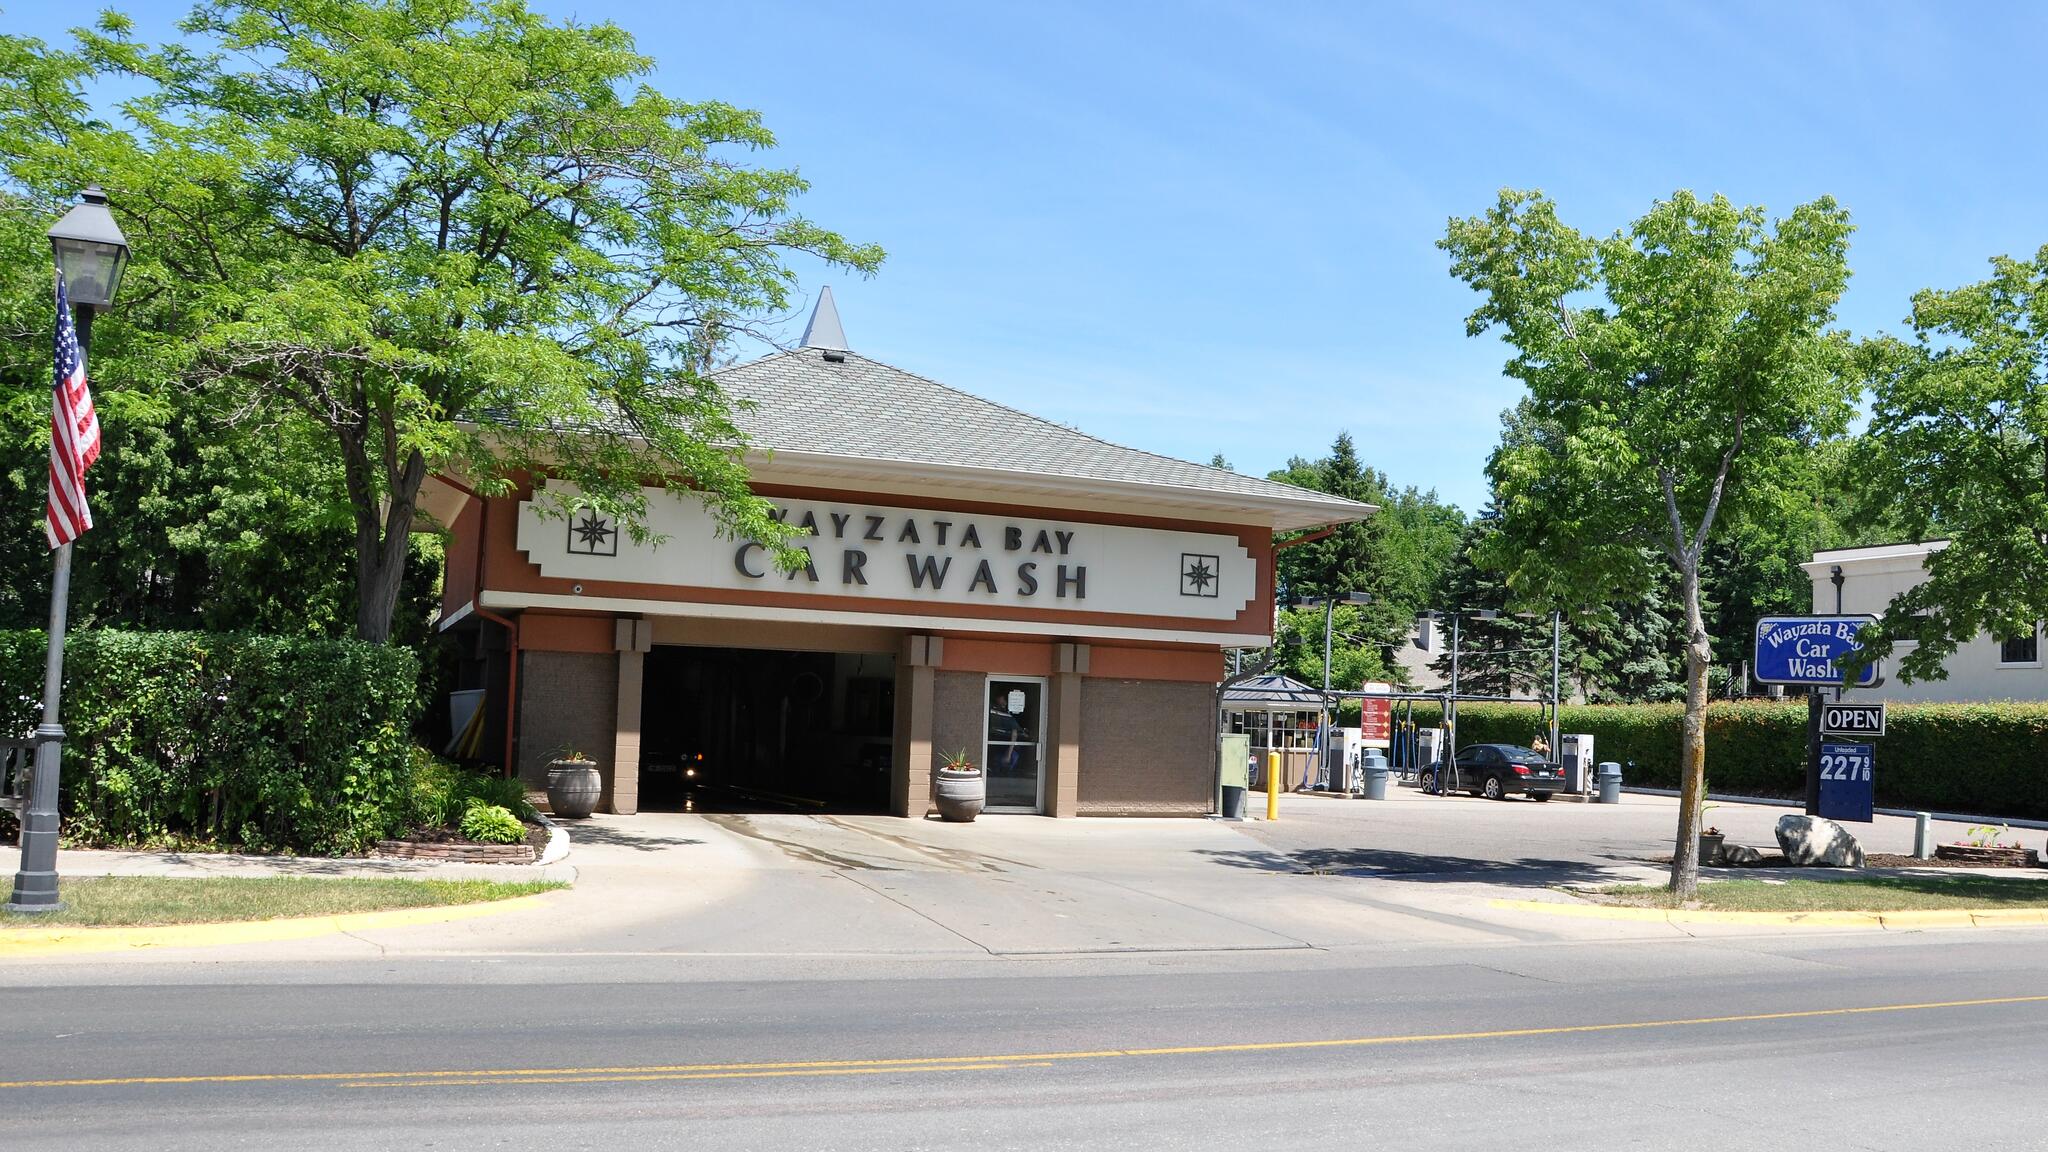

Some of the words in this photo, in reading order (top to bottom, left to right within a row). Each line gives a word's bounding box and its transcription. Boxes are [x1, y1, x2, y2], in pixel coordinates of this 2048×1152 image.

[1004, 526, 1074, 555] BAY
[905, 553, 1087, 599] WASH
[1767, 620, 1831, 649] Wayzata
[1796, 638, 1830, 658] Car
[1788, 658, 1838, 678] Wash
[1827, 709, 1880, 729] OPEN
[1820, 755, 1862, 781] 227
